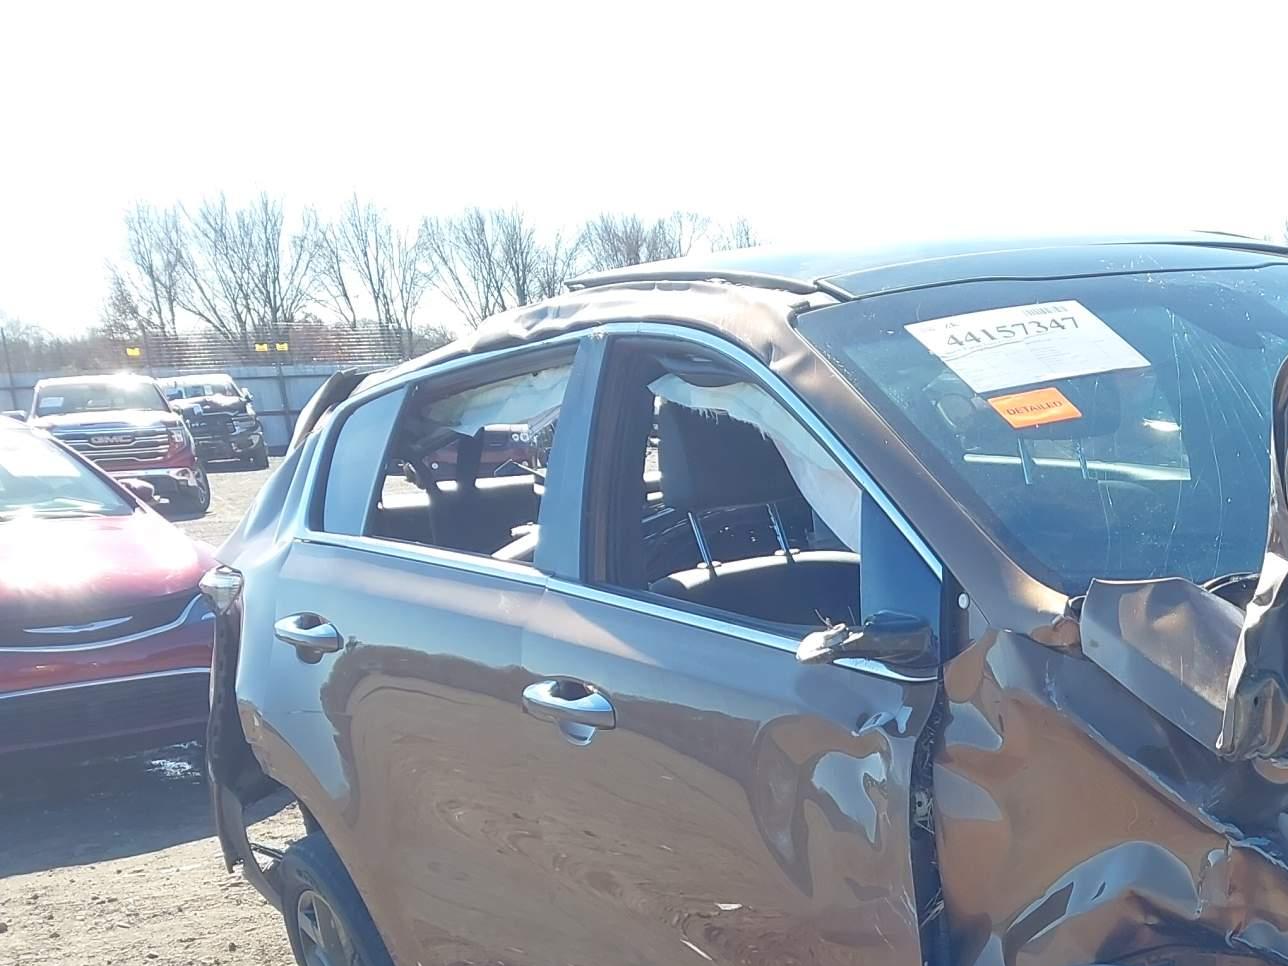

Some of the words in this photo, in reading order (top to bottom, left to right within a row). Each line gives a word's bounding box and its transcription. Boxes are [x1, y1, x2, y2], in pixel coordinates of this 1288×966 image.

[947, 316, 1080, 347] 44157347
[1006, 400, 1063, 416] DETAILED
[90, 434, 133, 444] GMC
